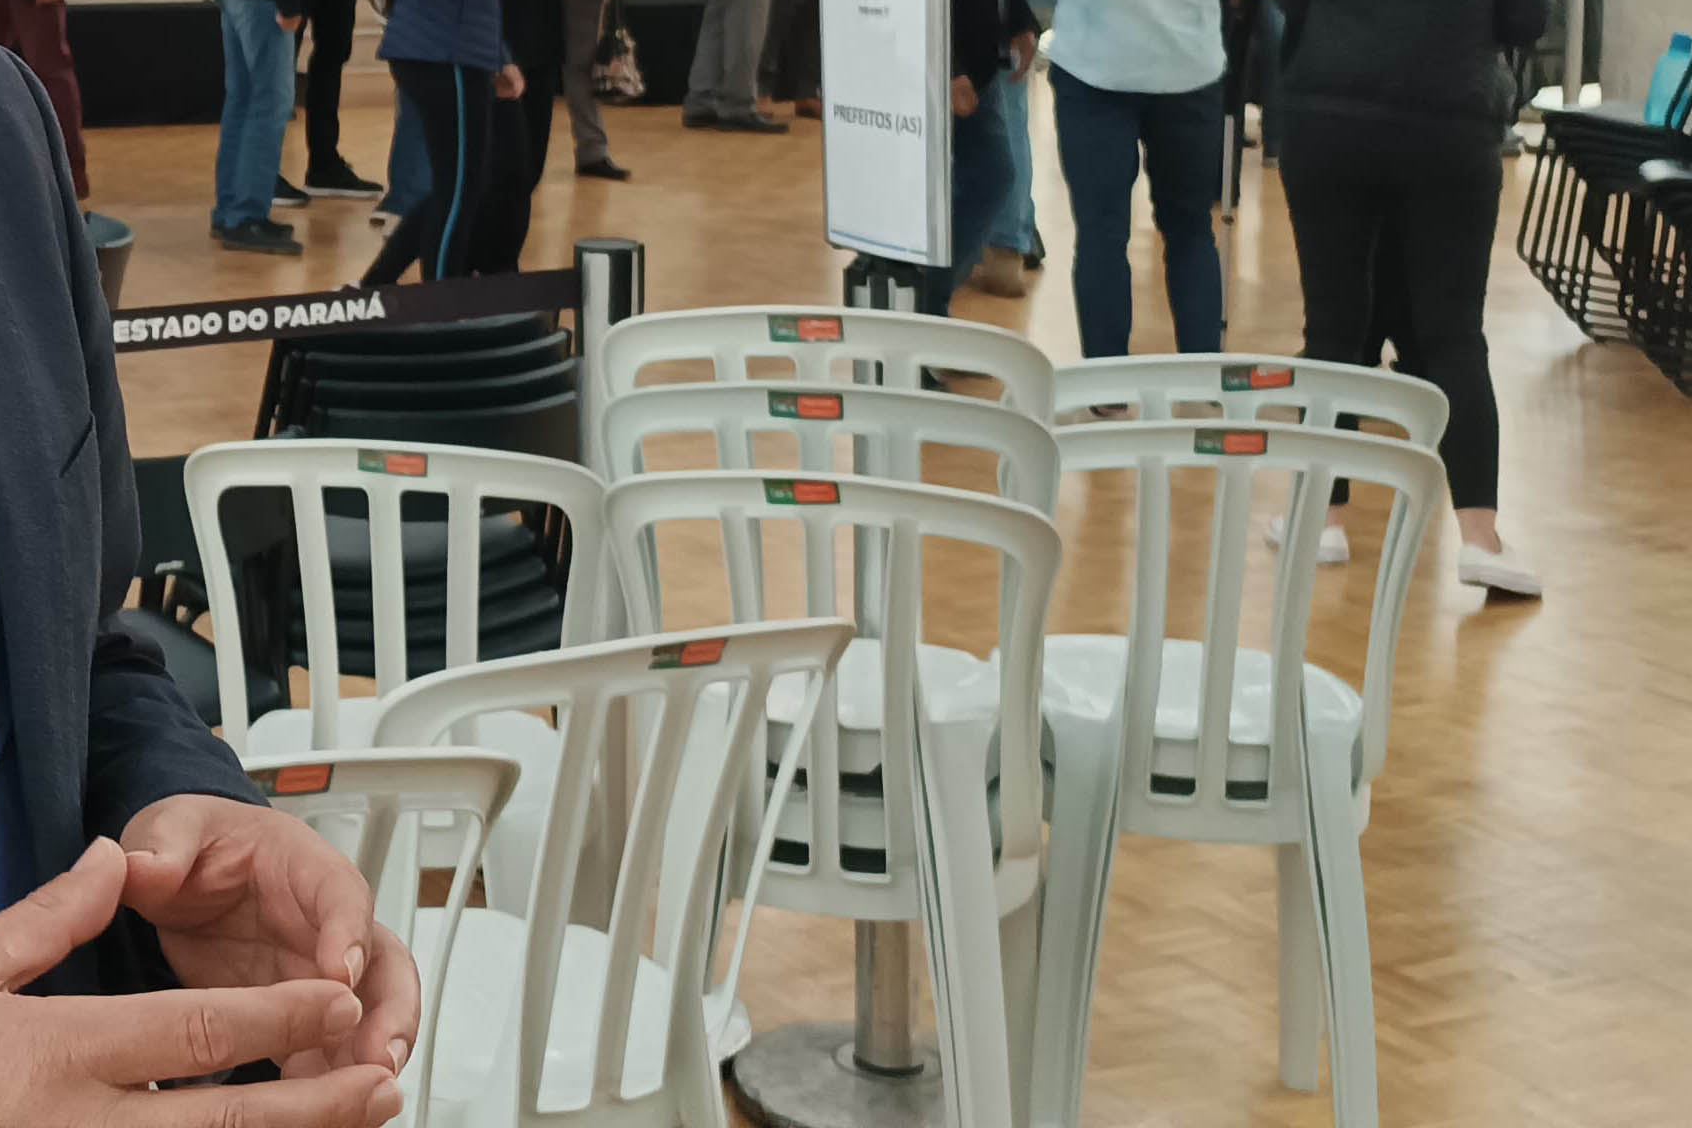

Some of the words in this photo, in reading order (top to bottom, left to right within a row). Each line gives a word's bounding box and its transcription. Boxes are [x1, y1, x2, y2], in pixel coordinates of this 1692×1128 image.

[833, 104, 892, 130] PREFEITOS
[895, 114, 922, 138] (AS)
[113, 311, 222, 343] ESTADO
[228, 308, 268, 333] DO
[274, 291, 385, 329] PARANÁ
